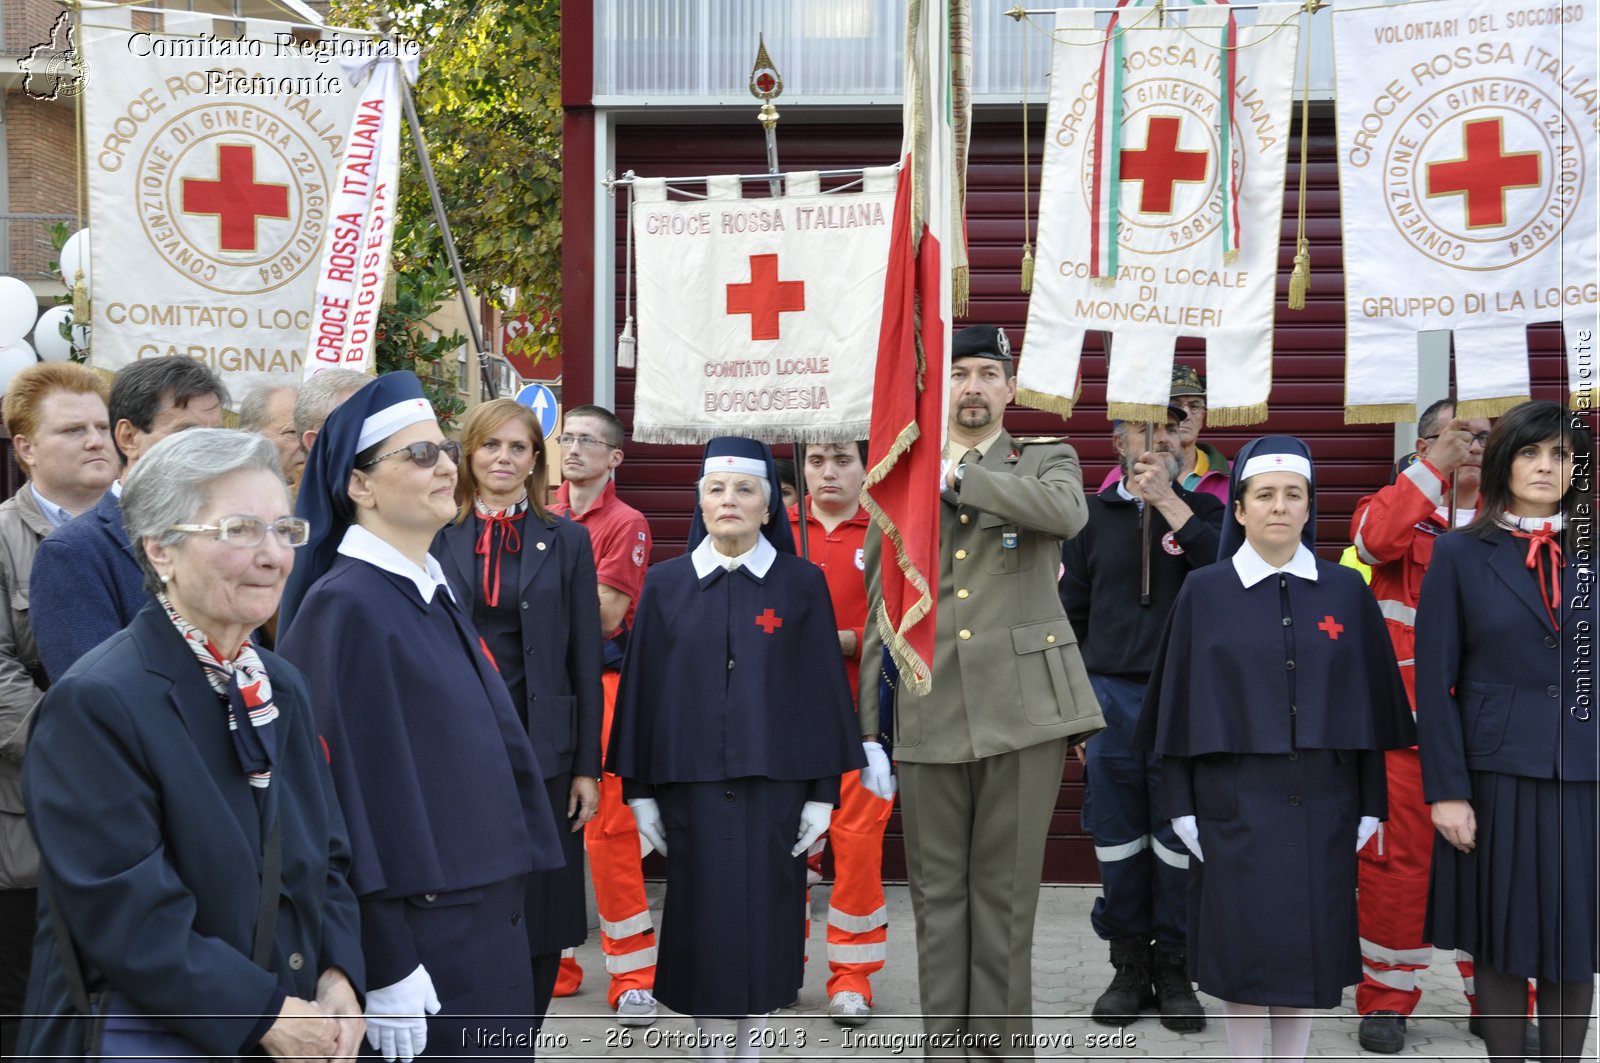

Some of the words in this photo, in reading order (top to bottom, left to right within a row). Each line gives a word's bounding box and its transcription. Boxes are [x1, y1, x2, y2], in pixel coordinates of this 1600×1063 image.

[1374, 18, 1458, 44] VOLONTARI
[1468, 14, 1498, 35] DEL
[1506, 4, 1584, 29] SOCCORSO
[1137, 84, 1215, 117] GINEVRA
[1349, 79, 1412, 168] CROCE
[1411, 42, 1515, 87] ROSSA
[1446, 83, 1542, 115] GINEVRA
[98, 87, 166, 172] CROCE
[170, 121, 195, 144] DI
[200, 110, 291, 149] GINEVRA
[1415, 106, 1440, 129] DI
[1543, 114, 1568, 139] 22
[342, 99, 384, 196] ITALIANA
[291, 152, 316, 177] 22
[1390, 135, 1465, 261] CONVENZIONE
[1549, 145, 1578, 218] AGOSTO
[144, 146, 217, 281] CONVENZIONE
[296, 182, 324, 253] AGOSTO
[646, 212, 711, 235] CROCE
[721, 209, 785, 233] ROSSA
[796, 202, 886, 230] ITALIANA
[1168, 213, 1212, 245] 1864
[327, 212, 363, 282] ROSSA
[1509, 220, 1554, 257] 1864
[259, 251, 301, 284] 1864
[1060, 261, 1156, 283] COTATO
[1165, 267, 1248, 288] LOCALE
[1139, 285, 1158, 302] DI
[1363, 295, 1455, 318] GRUPPO
[1464, 293, 1486, 314] DI
[1496, 290, 1525, 311] LA
[106, 302, 249, 329] COMITATO
[258, 308, 310, 330] LOC
[316, 295, 349, 363] CROCE
[1075, 299, 1222, 327] MONCALIERI
[704, 360, 770, 377] COMITATO
[776, 357, 829, 375] LOCALE
[704, 386, 830, 412] BORGOSESIA
